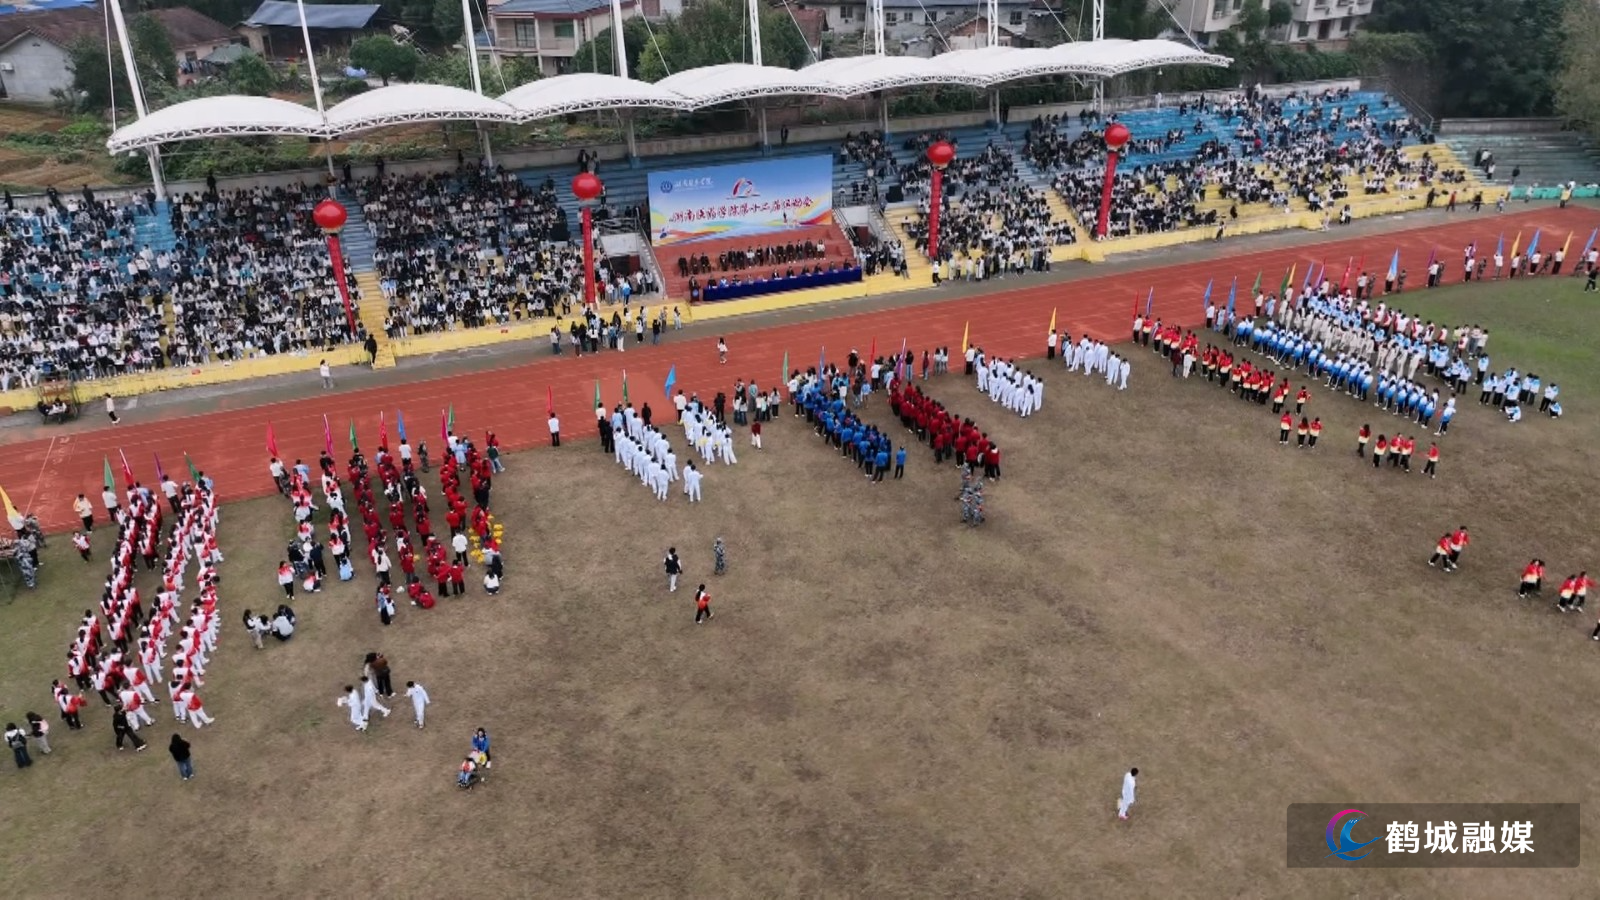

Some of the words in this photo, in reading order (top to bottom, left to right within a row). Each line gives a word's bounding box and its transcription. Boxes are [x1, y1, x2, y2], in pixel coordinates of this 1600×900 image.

[669, 196, 813, 222] 湖南医药学院第十二届运动会
